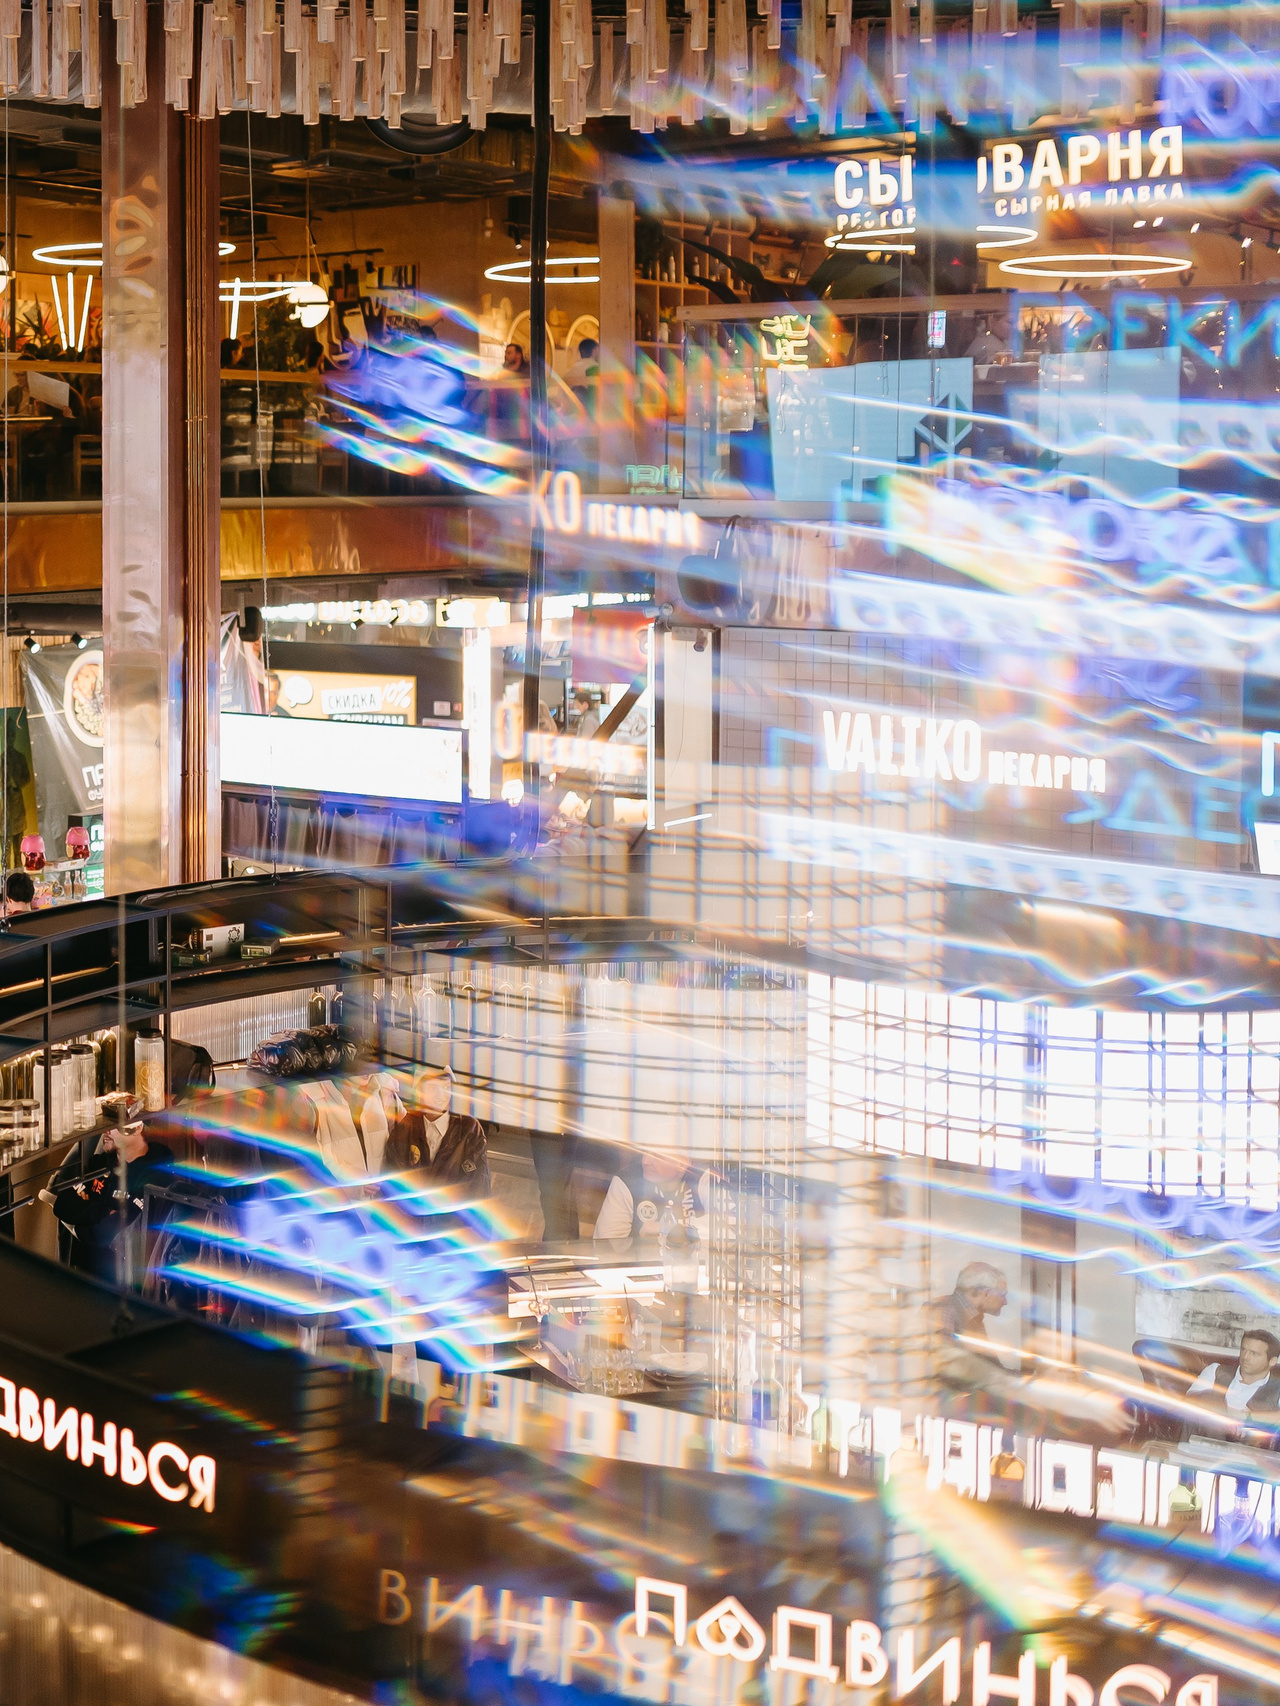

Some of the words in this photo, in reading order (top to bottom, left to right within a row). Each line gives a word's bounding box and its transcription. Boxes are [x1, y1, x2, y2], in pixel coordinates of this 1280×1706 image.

[994, 190, 1091, 218] СЫРНАЯ
[1105, 183, 1184, 206] ЛАВКА
[328, 693, 377, 710] СКИДКА
[822, 710, 982, 783] VALIKO
